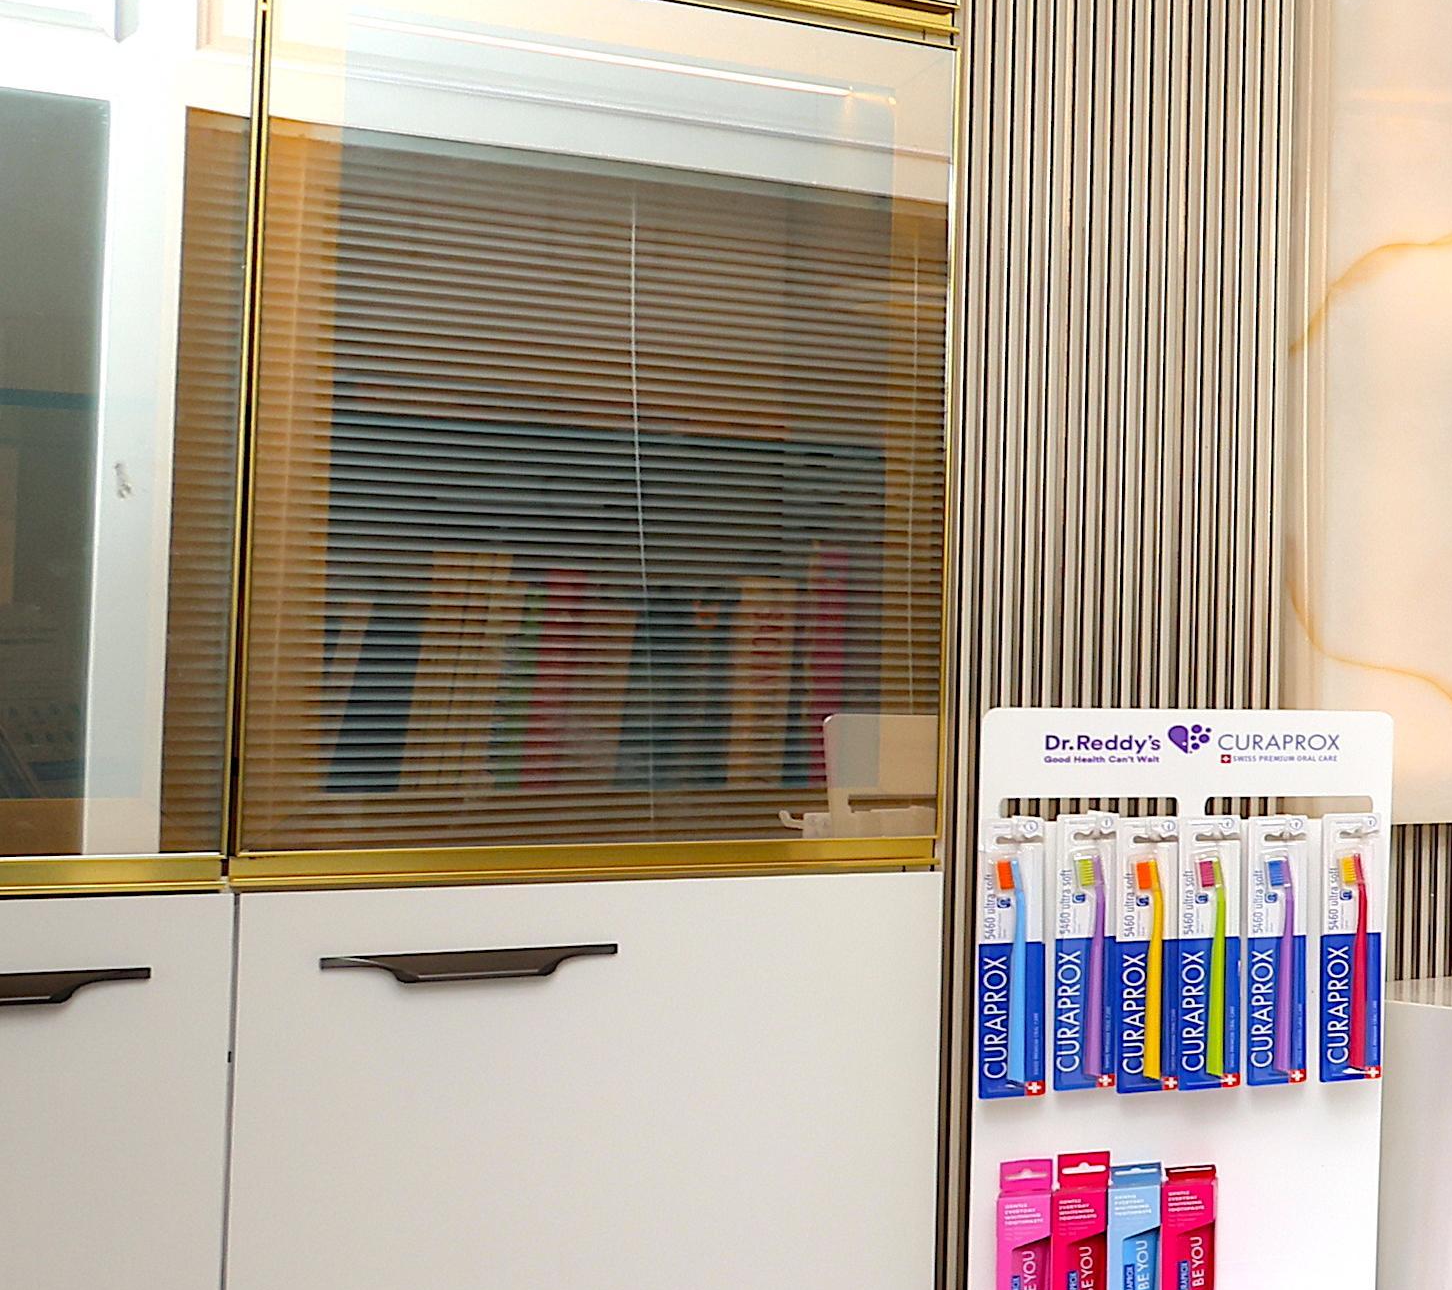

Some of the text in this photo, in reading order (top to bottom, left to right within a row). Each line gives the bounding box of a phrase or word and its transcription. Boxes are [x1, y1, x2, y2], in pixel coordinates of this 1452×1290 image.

[1044, 756, 1071, 764] Good
[1074, 756, 1105, 764] Health
[1045, 734, 1161, 754] Dr.Reddy's
[1218, 734, 1340, 751] CURAPROX
[983, 956, 1008, 1079] CURAPROX
[1056, 951, 1081, 1072] CURAPROX
[1122, 953, 1146, 1074] CURAPROX
[1182, 951, 1205, 1072] CURAPROX
[1250, 949, 1274, 1068] CURAPROX
[1327, 946, 1349, 1064] CURAPROX
[1022, 1250, 1036, 1283] YOU
[1079, 1246, 1094, 1279] YOU
[1136, 1240, 1150, 1290] BE YOU
[1190, 1236, 1204, 1287] BE YOU
